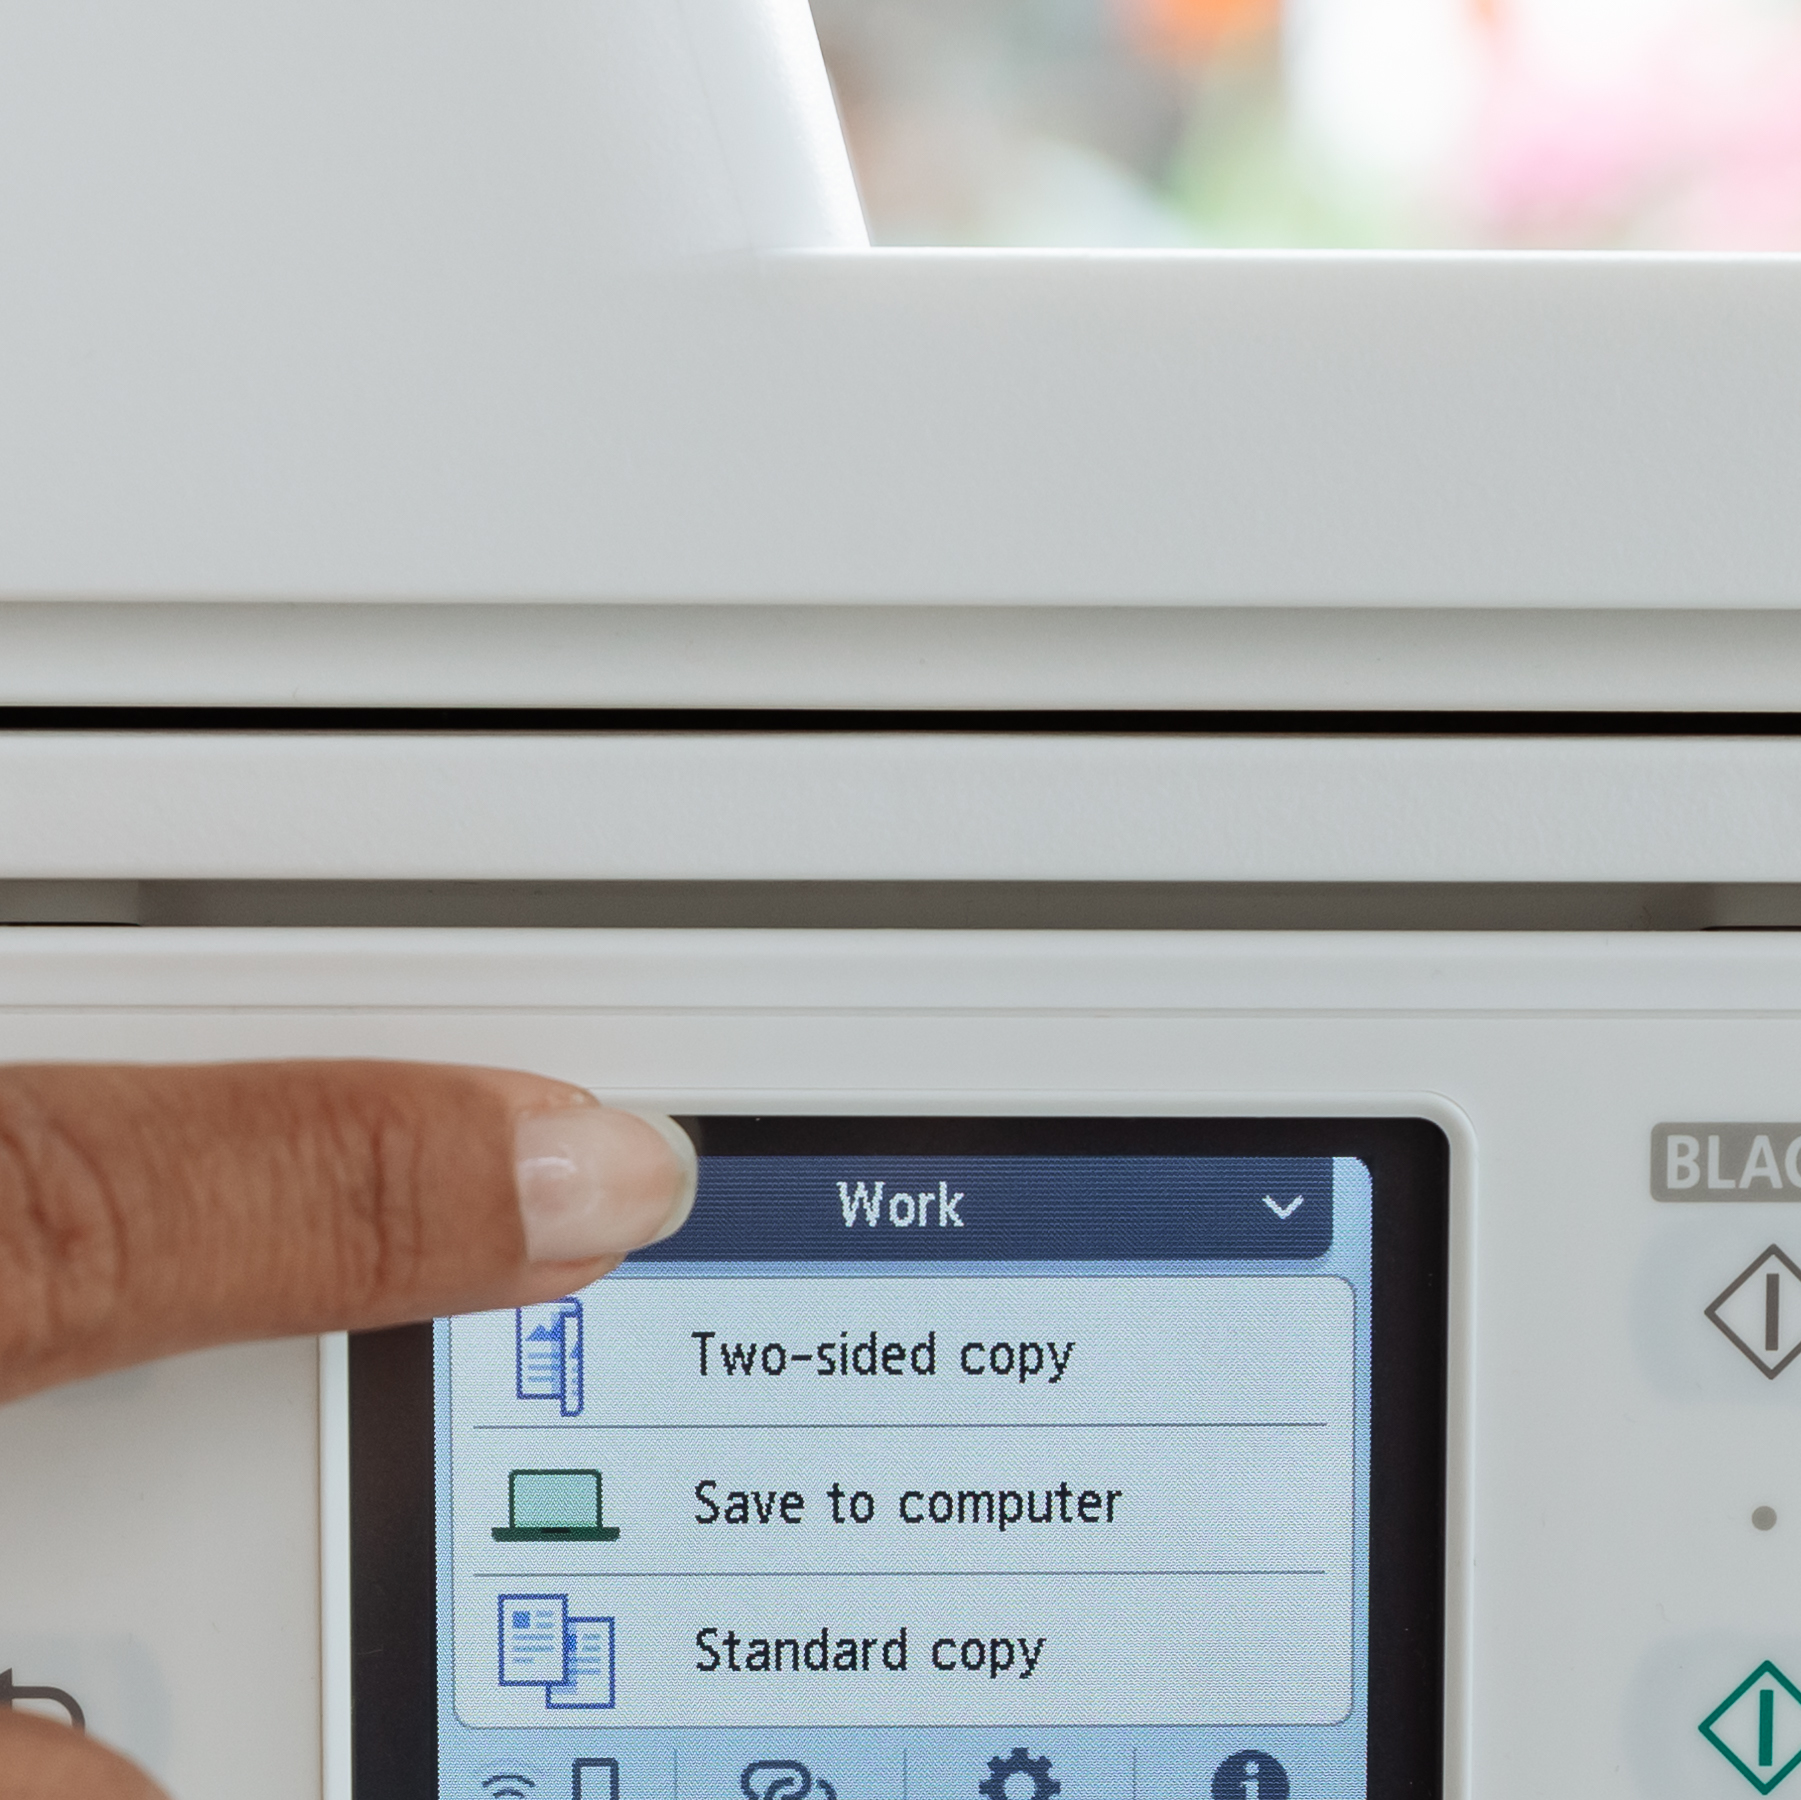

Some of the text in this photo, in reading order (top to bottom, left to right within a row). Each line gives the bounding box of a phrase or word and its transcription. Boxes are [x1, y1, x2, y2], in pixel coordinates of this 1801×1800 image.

[836, 1180, 964, 1229] Work
[690, 1329, 1075, 1385] Two-sided copy
[693, 1478, 1123, 1533] Save to computer
[694, 1625, 1046, 1681] Standard copy
